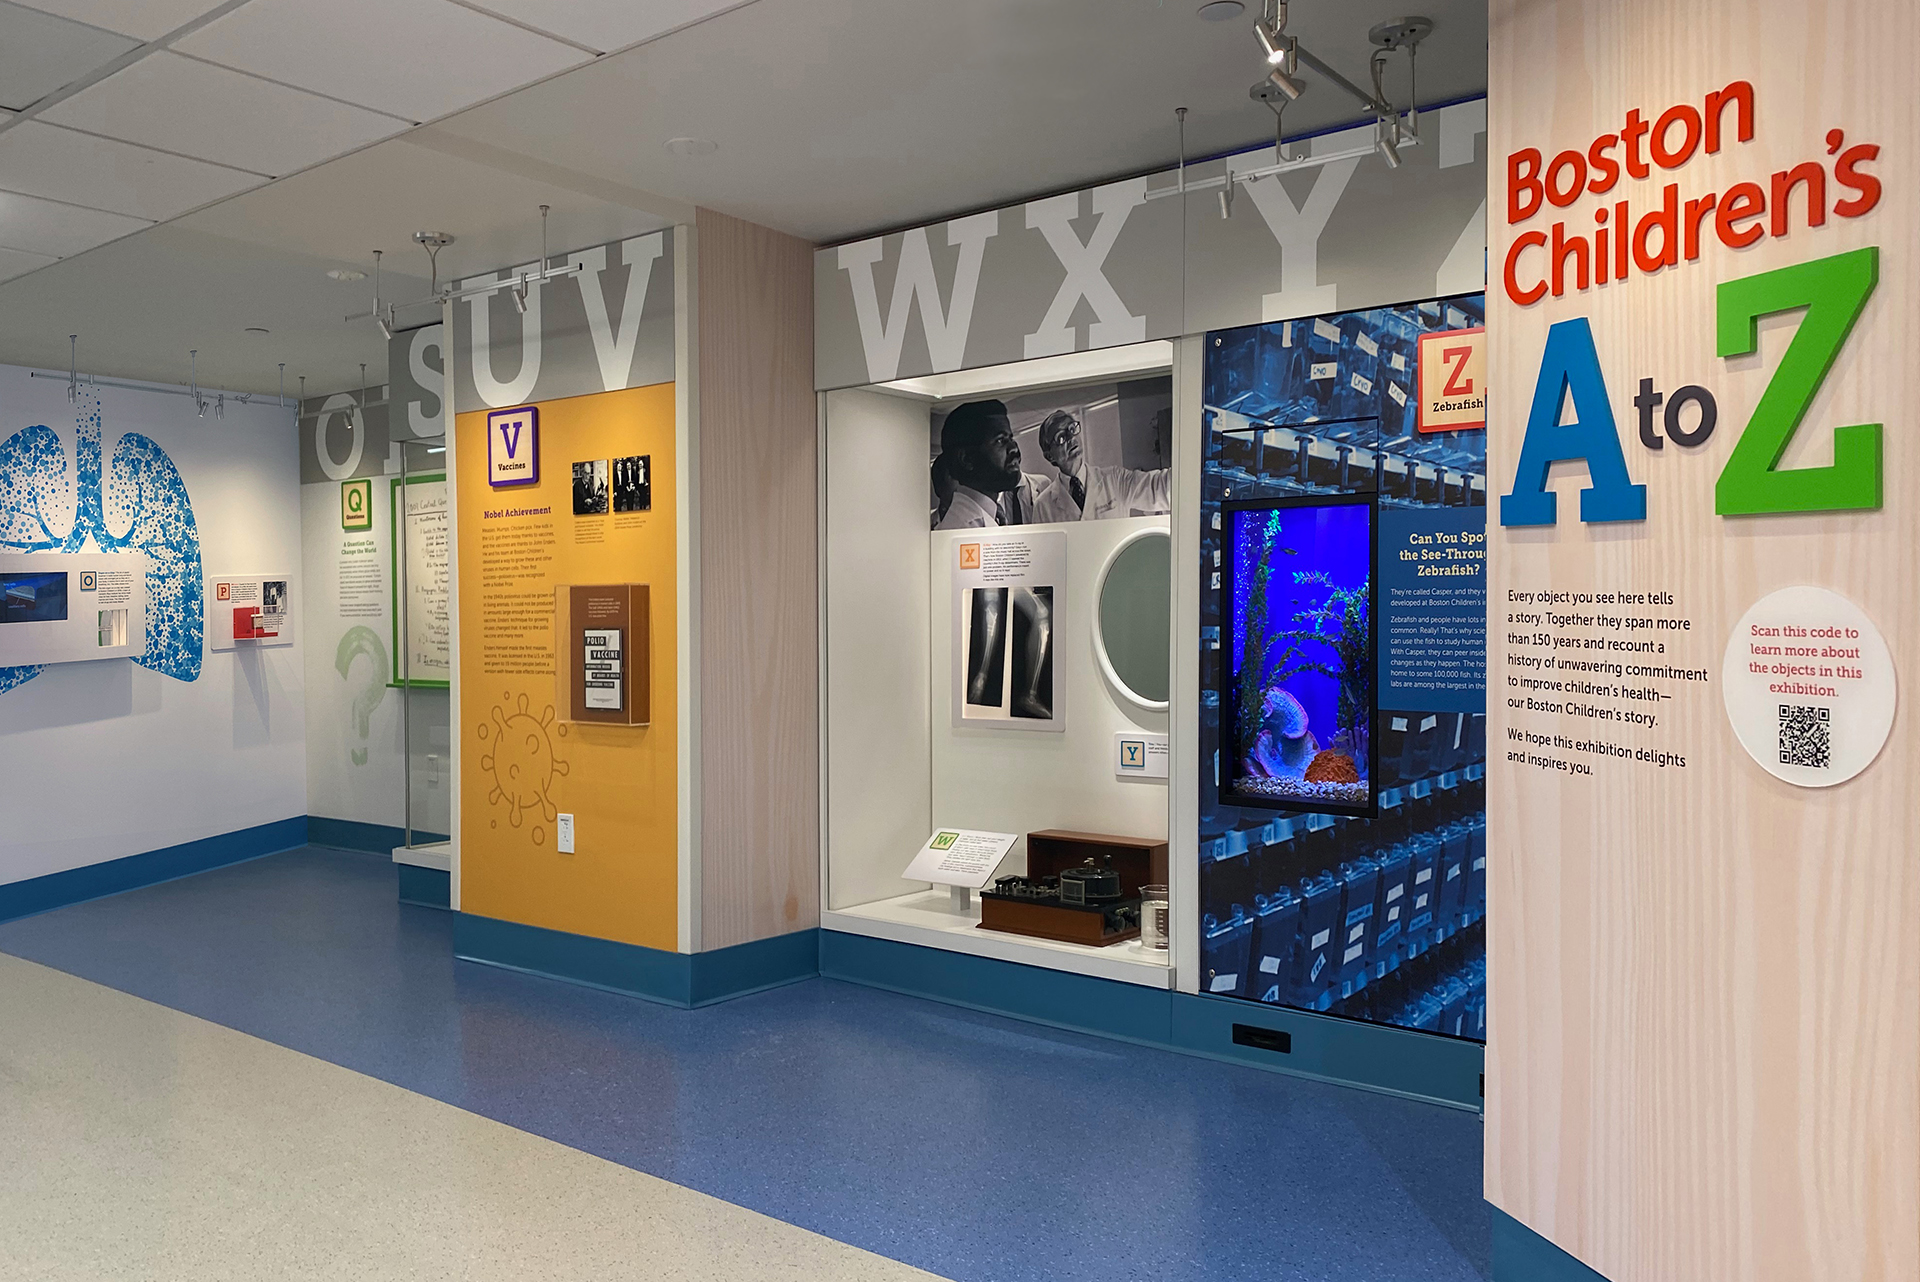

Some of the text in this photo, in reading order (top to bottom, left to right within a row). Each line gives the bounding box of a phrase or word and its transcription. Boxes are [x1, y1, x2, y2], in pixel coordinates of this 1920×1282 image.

[1508, 80, 1754, 224] Boston
[1504, 128, 1882, 306] Children's
[837, 210, 998, 382] W
[1024, 175, 1147, 359] X
[1226, 121, 1375, 322] Y
[461, 232, 663, 407] U V
[1443, 346, 1473, 396] Z
[1500, 246, 1884, 527] A to Z
[1433, 398, 1484, 412] Zebrafish
[500, 421, 522, 459] V
[498, 462, 526, 471] Vaccines
[348, 488, 362, 512] Q
[484, 506, 551, 519] Nobel Achievement
[1410, 534, 1432, 544] Can
[1436, 533, 1458, 543] You
[965, 549, 975, 562] X
[1400, 550, 1418, 560] the
[1418, 564, 1480, 576] Zebrafish?
[220, 586, 227, 596] P
[1509, 590, 1673, 606] Every object you see here tells
[1508, 612, 1690, 631] a story. Together they span more
[1752, 625, 1858, 638] Scan this code to
[1508, 632, 1664, 653] than 150 years and recount a
[1750, 643, 1860, 658] learn more about
[1508, 653, 1707, 681] history of unwavering commitment
[1750, 662, 1862, 678] the objects in this
[1447, 682, 1467, 690] largest
[1508, 675, 1518, 686] to
[1521, 676, 1562, 691] improve
[1565, 680, 1618, 697] children's
[1770, 682, 1838, 696] exhibition.
[1508, 698, 1658, 728] our Boston Children's story.
[1127, 746, 1139, 761] Y
[1508, 728, 1685, 767] We hope this exhibition delights
[1508, 752, 1592, 775] and inspires you.
[938, 836, 954, 846] W
